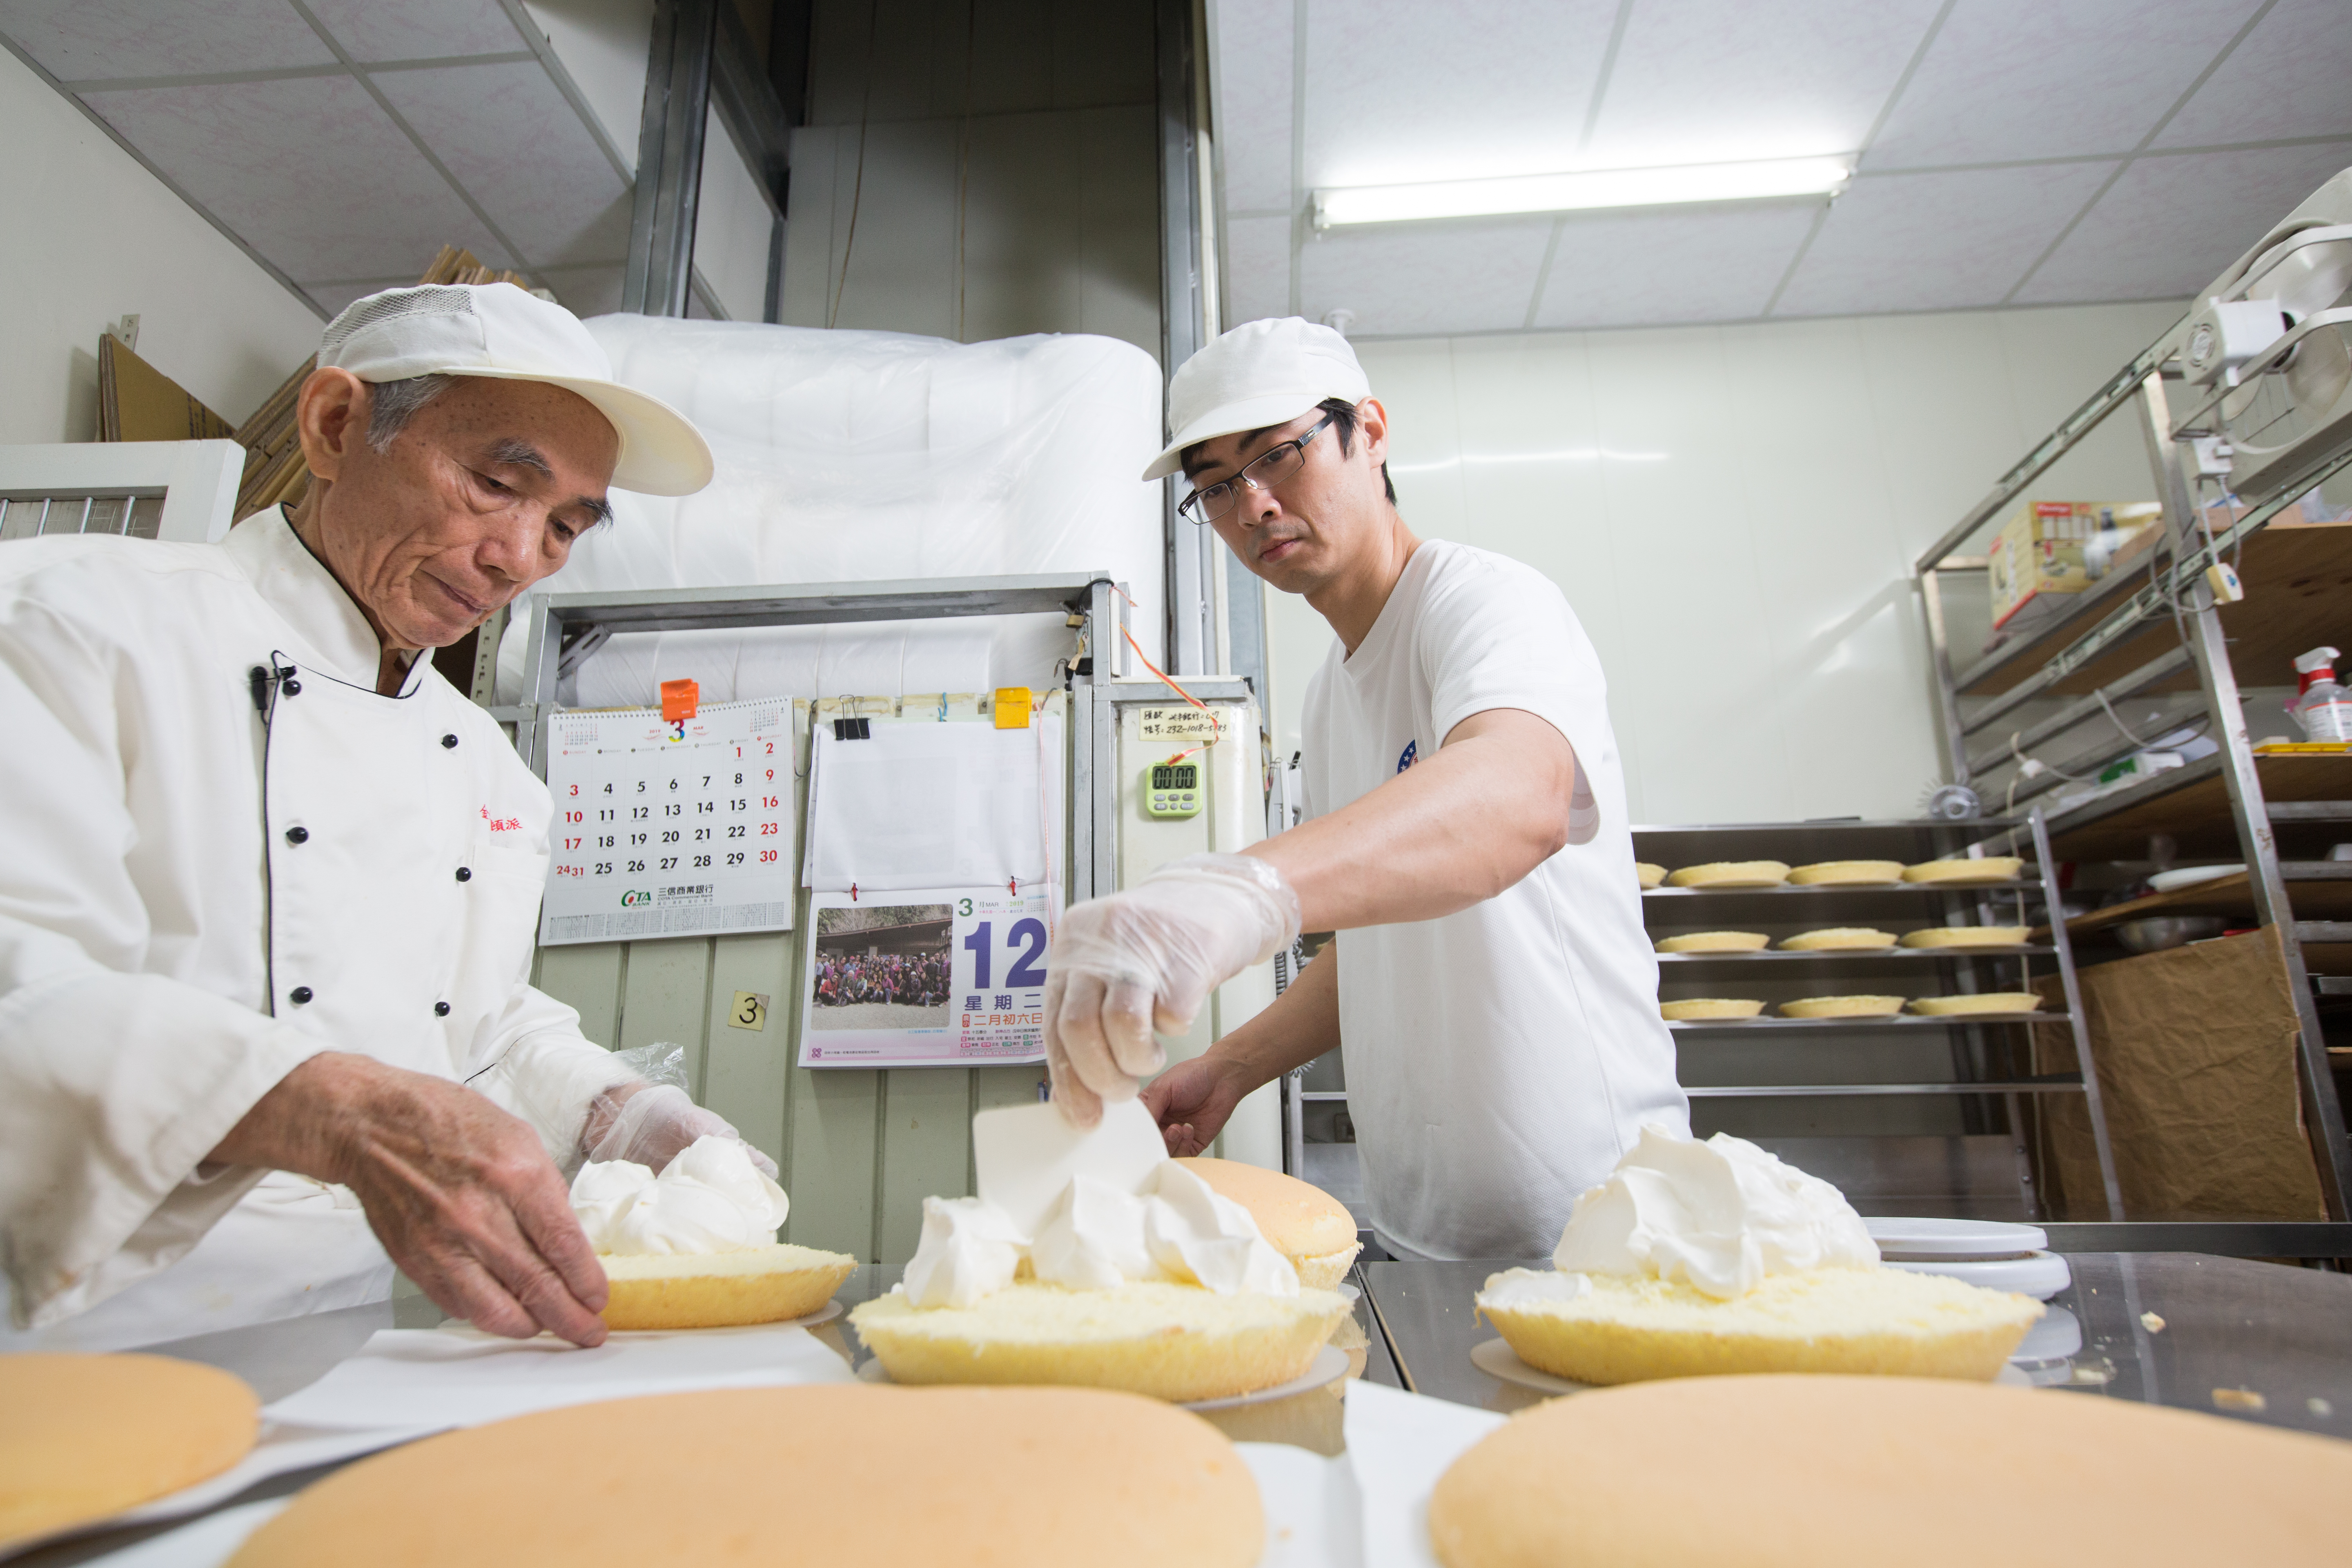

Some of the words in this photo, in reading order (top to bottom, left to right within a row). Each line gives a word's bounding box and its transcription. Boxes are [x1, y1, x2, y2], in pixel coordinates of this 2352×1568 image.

[668, 719, 685, 742] 3
[1167, 724, 1227, 734] 232-1018-583
[737, 747, 741, 757] 1
[766, 743, 773, 754] 2
[570, 785, 578, 796] 3
[604, 784, 612, 794] 4
[638, 782, 645, 792] 5
[670, 779, 677, 789] 6
[703, 776, 710, 786] 7
[735, 773, 742, 784] 8
[766, 769, 773, 781] 9
[566, 811, 582, 823] 10
[600, 810, 614, 821] 11
[633, 807, 648, 818] 12
[665, 804, 680, 815] 13
[698, 802, 713, 813] 14
[731, 799, 746, 811] 15
[763, 796, 778, 808] 16
[565, 838, 581, 850] 17
[599, 836, 614, 847] 18
[631, 833, 646, 845] 19
[662, 831, 679, 842] 20
[695, 829, 710, 840] 21
[728, 826, 745, 837] 22
[761, 823, 777, 835] 23
[557, 865, 570, 875] 24
[572, 867, 583, 876] 31
[595, 863, 612, 874] 25
[628, 860, 645, 872] 26
[660, 858, 678, 869] 27
[694, 855, 711, 867] 28
[727, 853, 744, 864] 29
[760, 850, 777, 862] 30
[658, 884, 714, 896] 三信商業銀行
[958, 898, 973, 917] 3
[964, 918, 1047, 989] 12
[739, 997, 758, 1024] 3
[964, 993, 1041, 1011] 星期二
[974, 1013, 1042, 1026] 二月初六日
